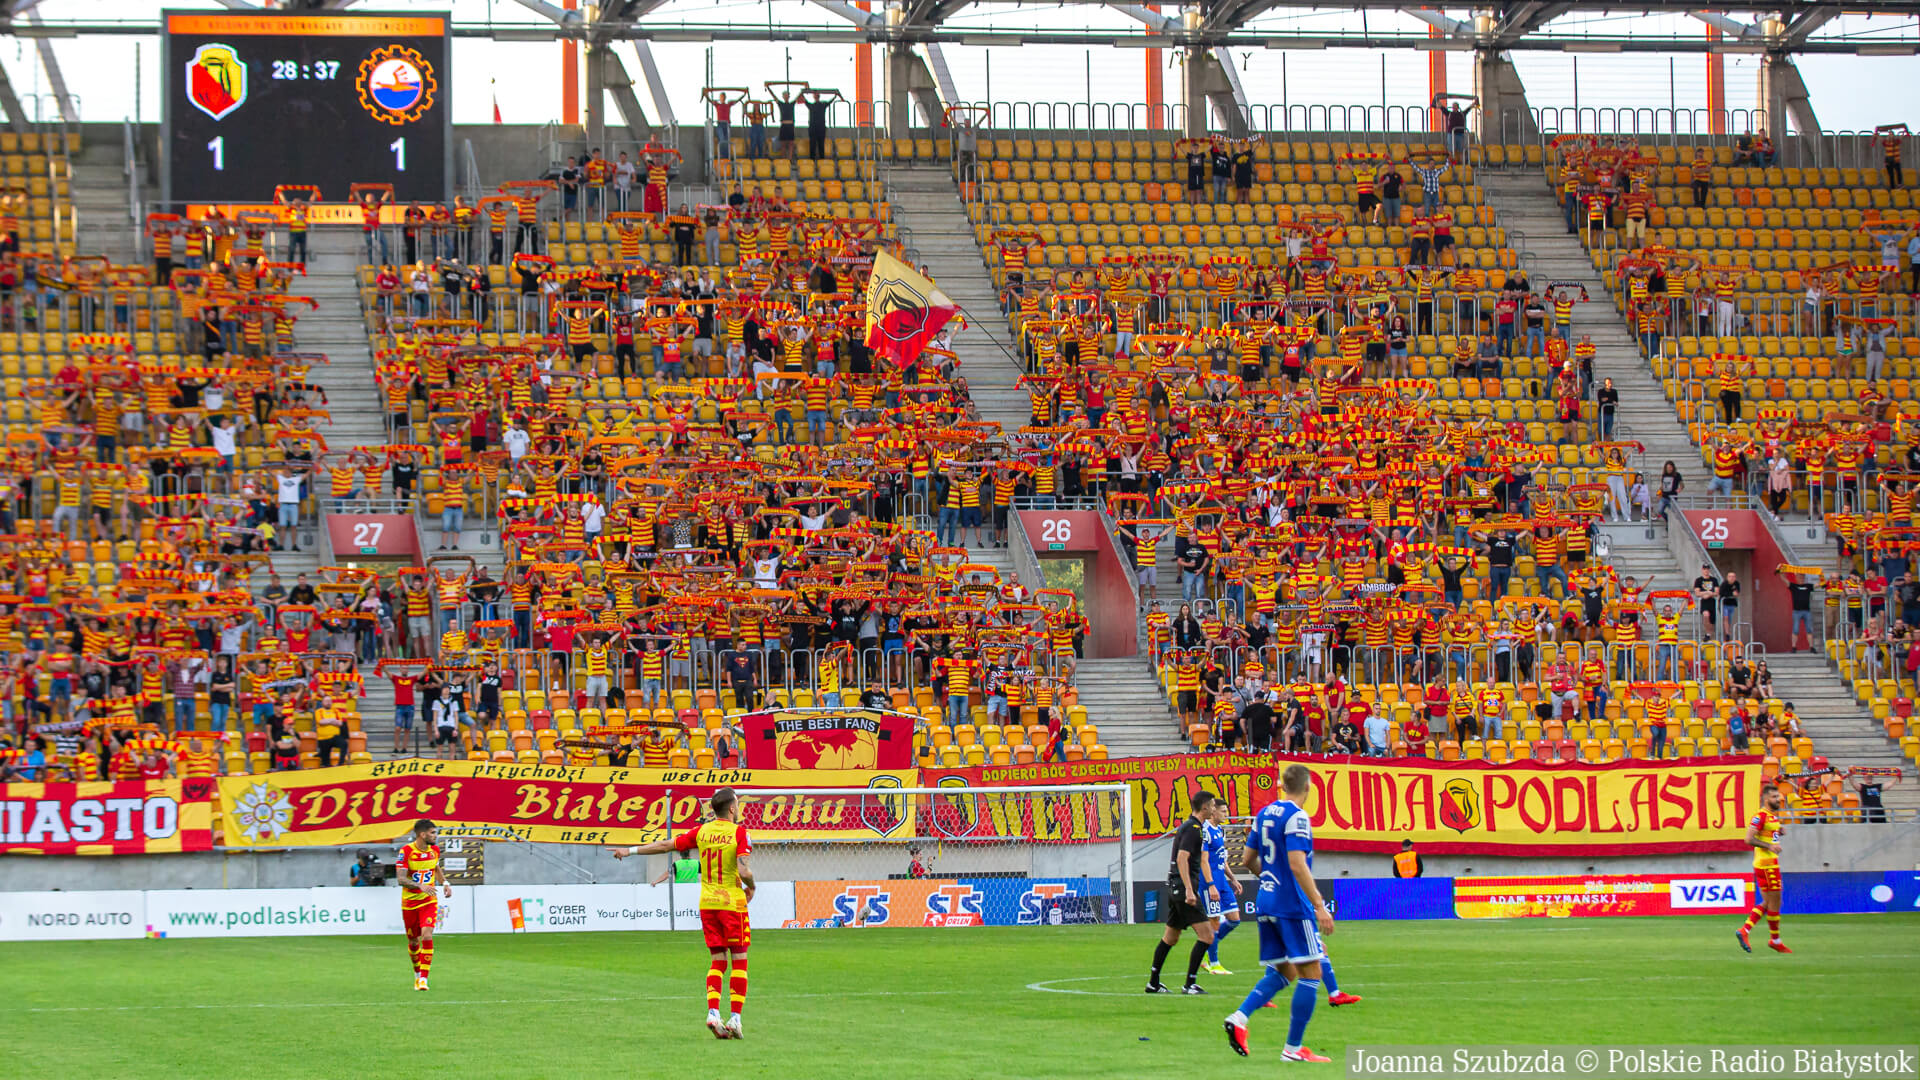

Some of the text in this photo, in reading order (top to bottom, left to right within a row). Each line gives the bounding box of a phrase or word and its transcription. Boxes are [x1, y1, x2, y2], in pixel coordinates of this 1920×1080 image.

[207, 136, 225, 171] 1
[390, 137, 406, 171] 1
[353, 523, 384, 546] 27
[1042, 519, 1071, 542] 26
[1701, 518, 1729, 540] 25
[779, 718, 876, 732] THE BEST FANS
[372, 759, 752, 785] Słońce przychodzi ze wschodu
[982, 767, 1037, 782] DOPIERO
[1041, 765, 1066, 779] BÓG
[1145, 758, 1181, 774] KIEDY
[1186, 755, 1226, 770] MAMY
[300, 781, 846, 837] Dzieci Białegooku
[1483, 770, 1748, 833] PODLASIA
[0, 797, 178, 843] IASTO
[447, 839, 461, 849] 21
[709, 834, 733, 844] IMAZ
[1261, 819, 1276, 865] 5
[412, 870, 432, 884] STS
[701, 848, 723, 885] 11
[926, 885, 983, 916] STS
[1018, 884, 1077, 925] ST
[1489, 894, 1526, 905] ADAM
[1676, 884, 1737, 902] VISA
[168, 904, 366, 930] www.podlaskie.eu
[549, 905, 586, 915] CYBER
[597, 906, 700, 920] Your Cyber Seurity
[833, 885, 890, 926] STS
[1210, 901, 1221, 913] 99
[28, 912, 132, 926] NORD AUTO
[549, 916, 587, 926] QUANT
